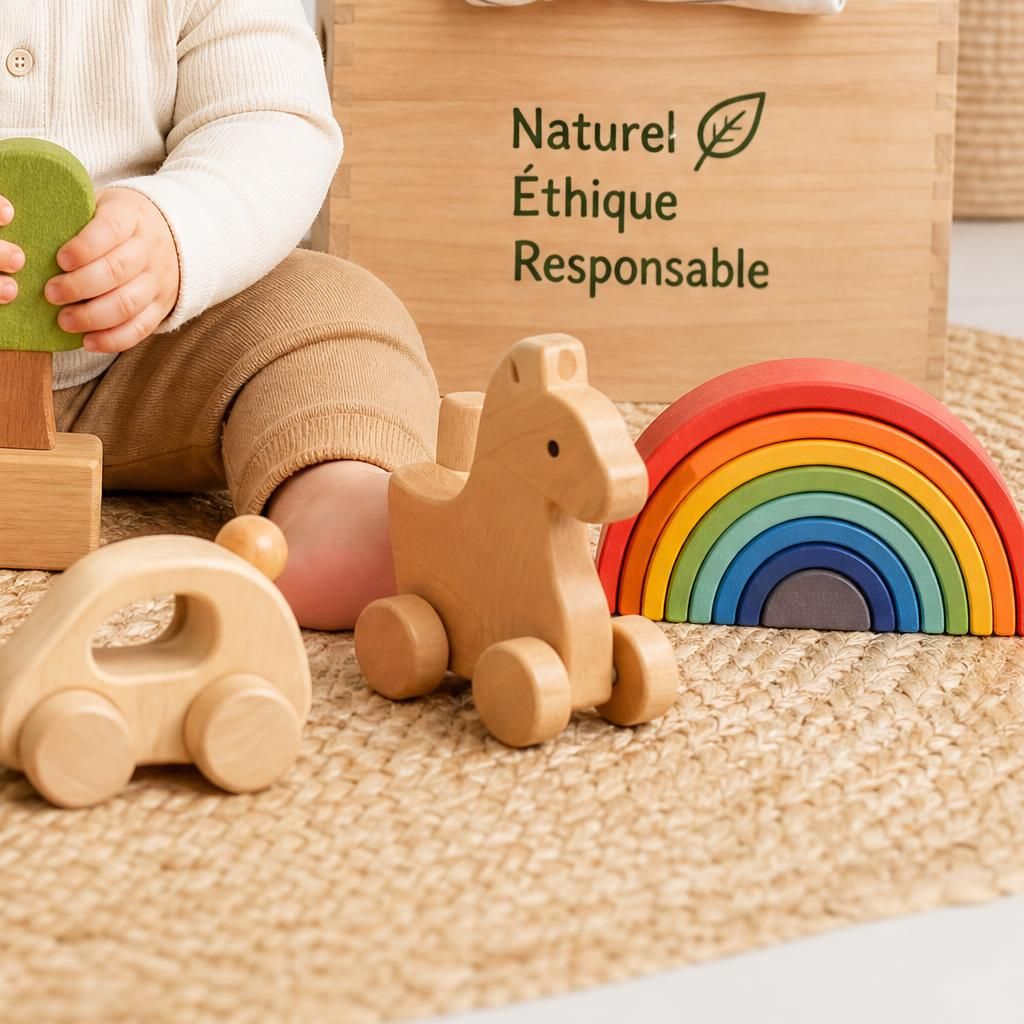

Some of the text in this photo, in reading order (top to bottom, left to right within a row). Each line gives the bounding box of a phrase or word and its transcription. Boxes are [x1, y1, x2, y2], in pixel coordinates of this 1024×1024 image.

[512, 106, 676, 154] Naturel
[512, 163, 678, 234] Éthique
[513, 239, 770, 299] Responsable
